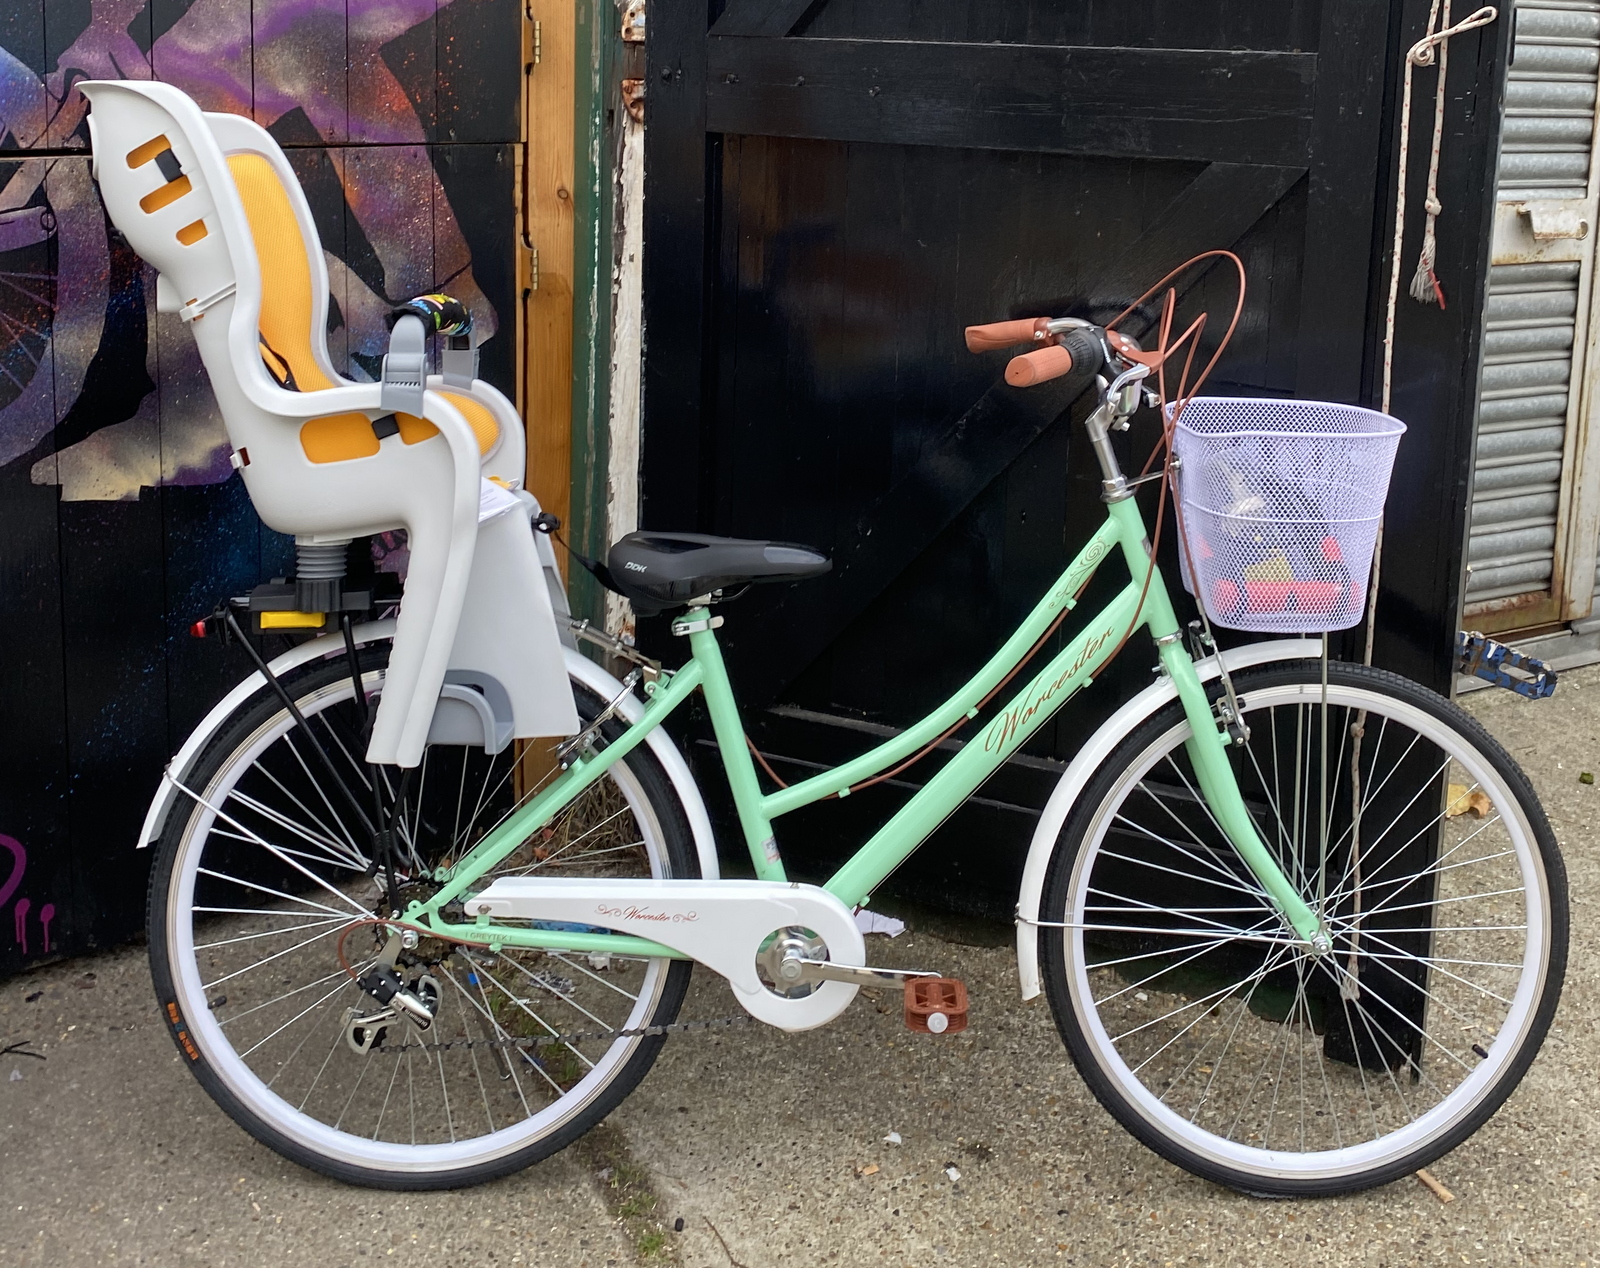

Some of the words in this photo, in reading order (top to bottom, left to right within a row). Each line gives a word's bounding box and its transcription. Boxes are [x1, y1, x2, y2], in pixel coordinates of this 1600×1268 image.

[624, 561, 648, 573] DDK
[985, 626, 1114, 754] Worcester
[623, 905, 671, 922] Worcester
